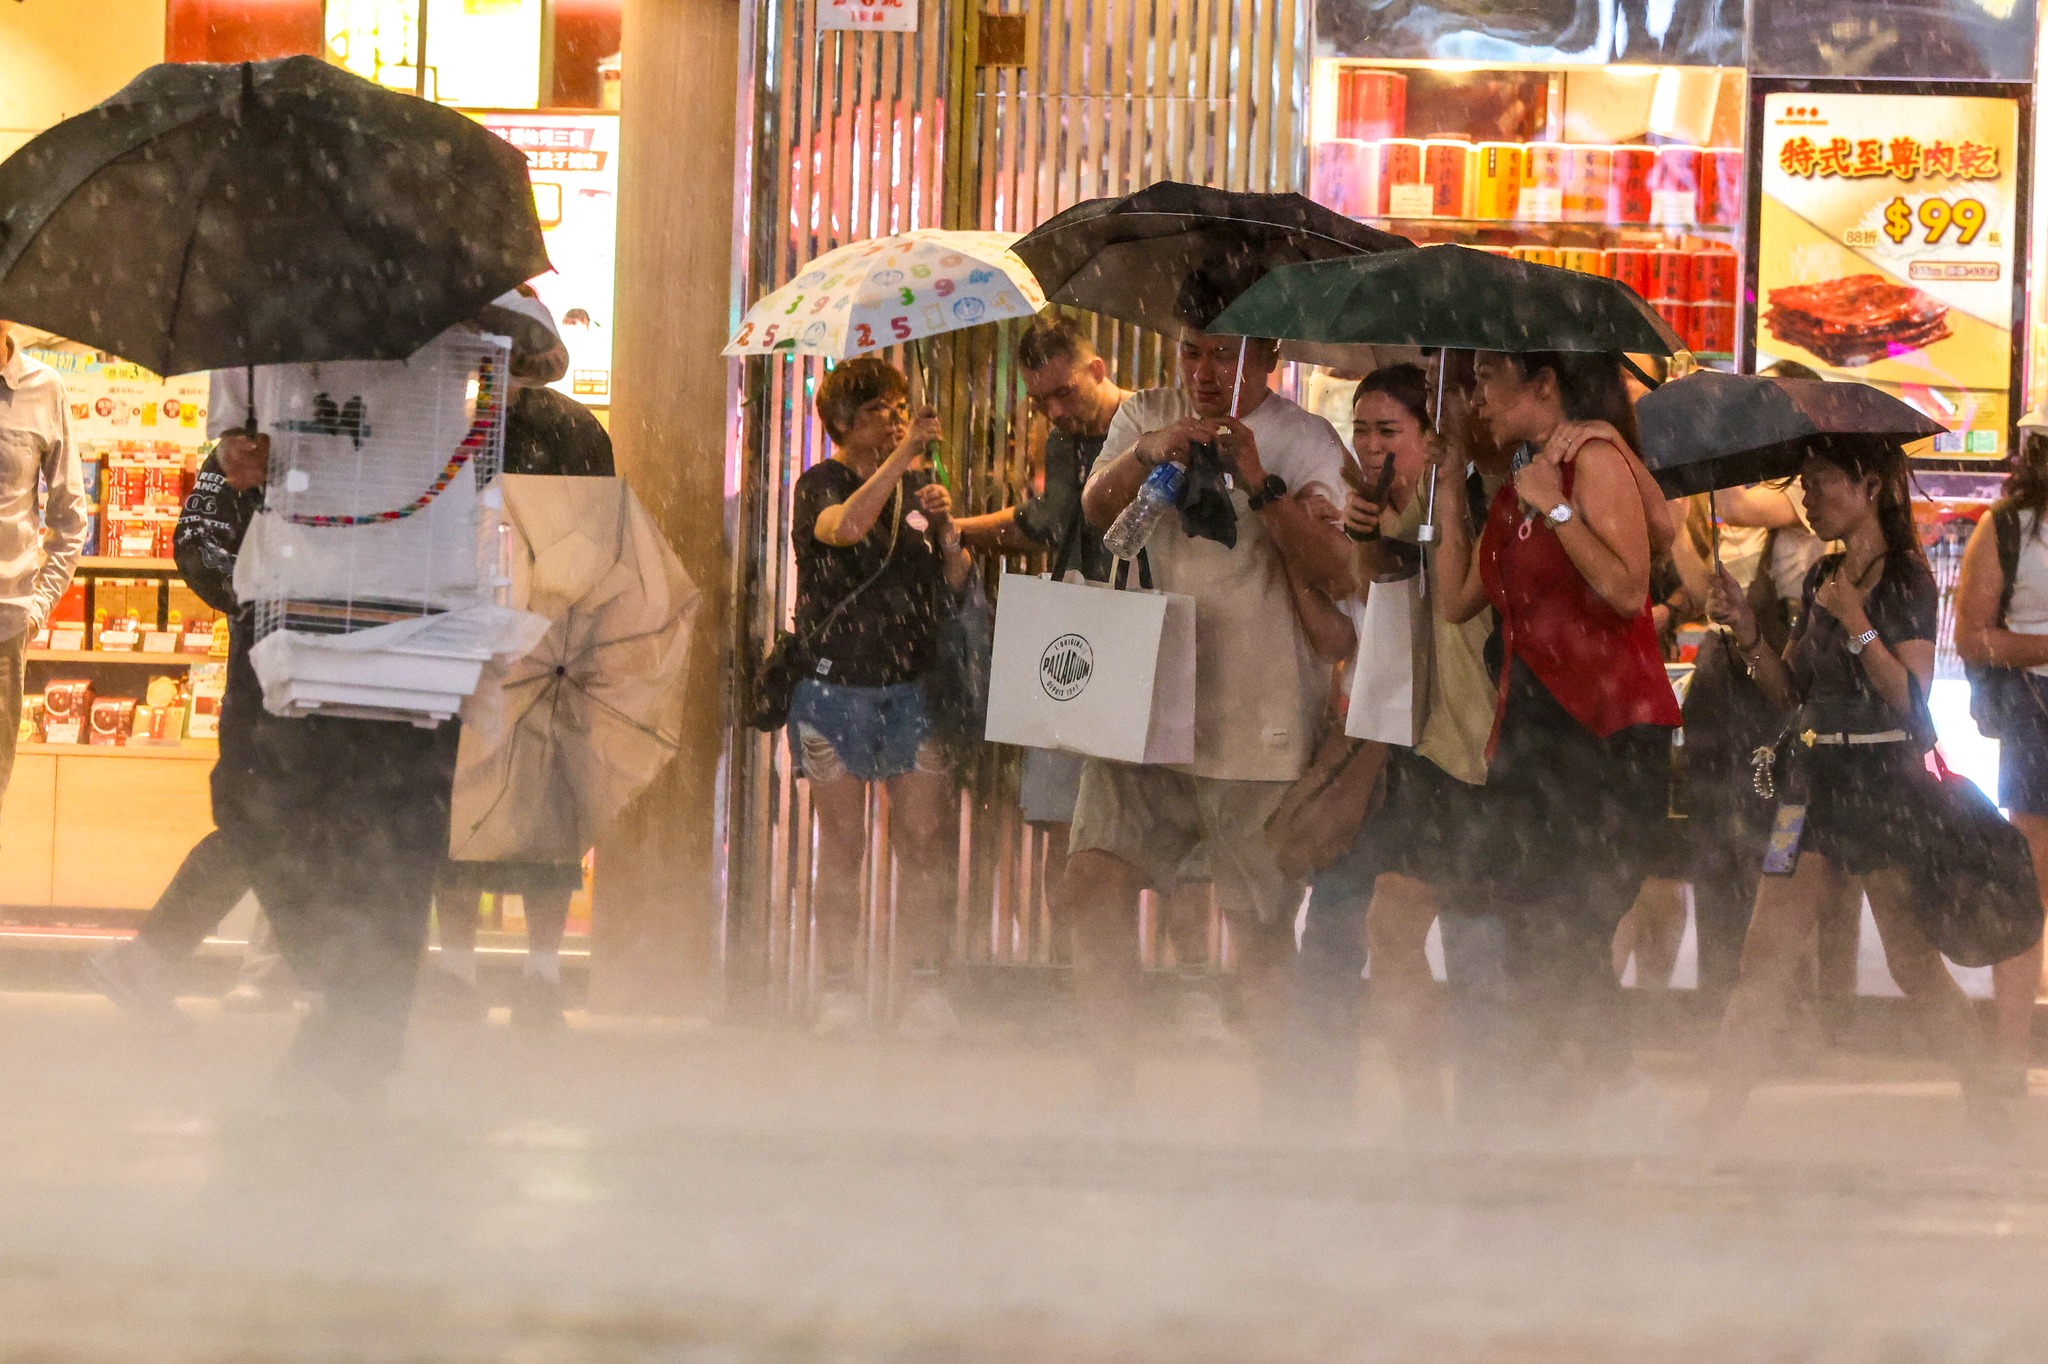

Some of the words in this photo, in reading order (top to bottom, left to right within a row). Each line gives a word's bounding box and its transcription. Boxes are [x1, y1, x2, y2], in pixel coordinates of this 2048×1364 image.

[1781, 138, 1999, 179] 特式至尊肉乾
[1883, 197, 1986, 245] $99
[1845, 231, 1877, 245] 88折
[899, 286, 916, 307] 3
[934, 278, 955, 298] 9
[737, 322, 755, 347] 2
[762, 323, 780, 348] 5
[854, 323, 876, 348] 2
[890, 316, 912, 340] 5
[1043, 649, 1090, 686] PALLADIUM
[1046, 681, 1064, 697] DEPUIS
